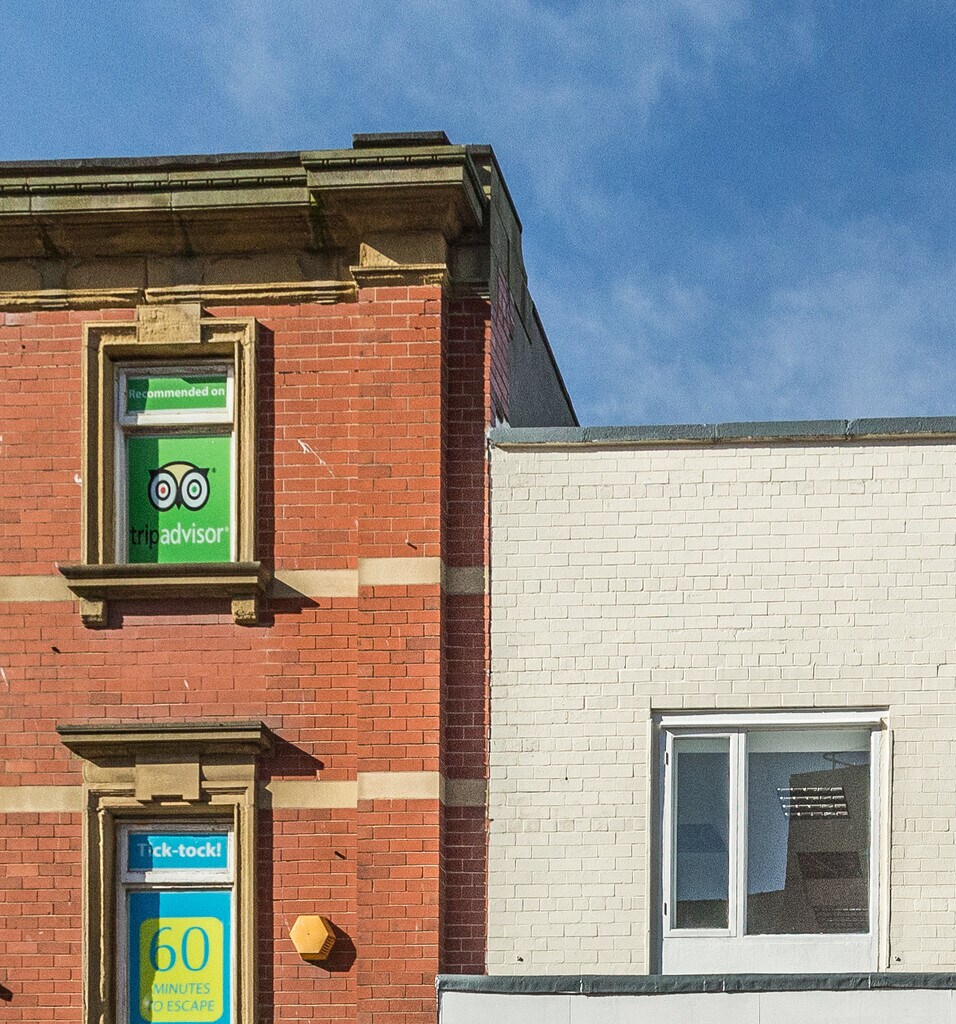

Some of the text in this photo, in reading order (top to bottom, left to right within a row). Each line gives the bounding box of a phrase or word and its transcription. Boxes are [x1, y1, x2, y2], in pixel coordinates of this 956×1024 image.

[129, 386, 225, 399] Recommended on
[137, 842, 222, 858] Tick-tock!
[150, 926, 210, 972] 60
[152, 982, 211, 995] MINUTES
[146, 1000, 215, 1012] TO ESCAPE
